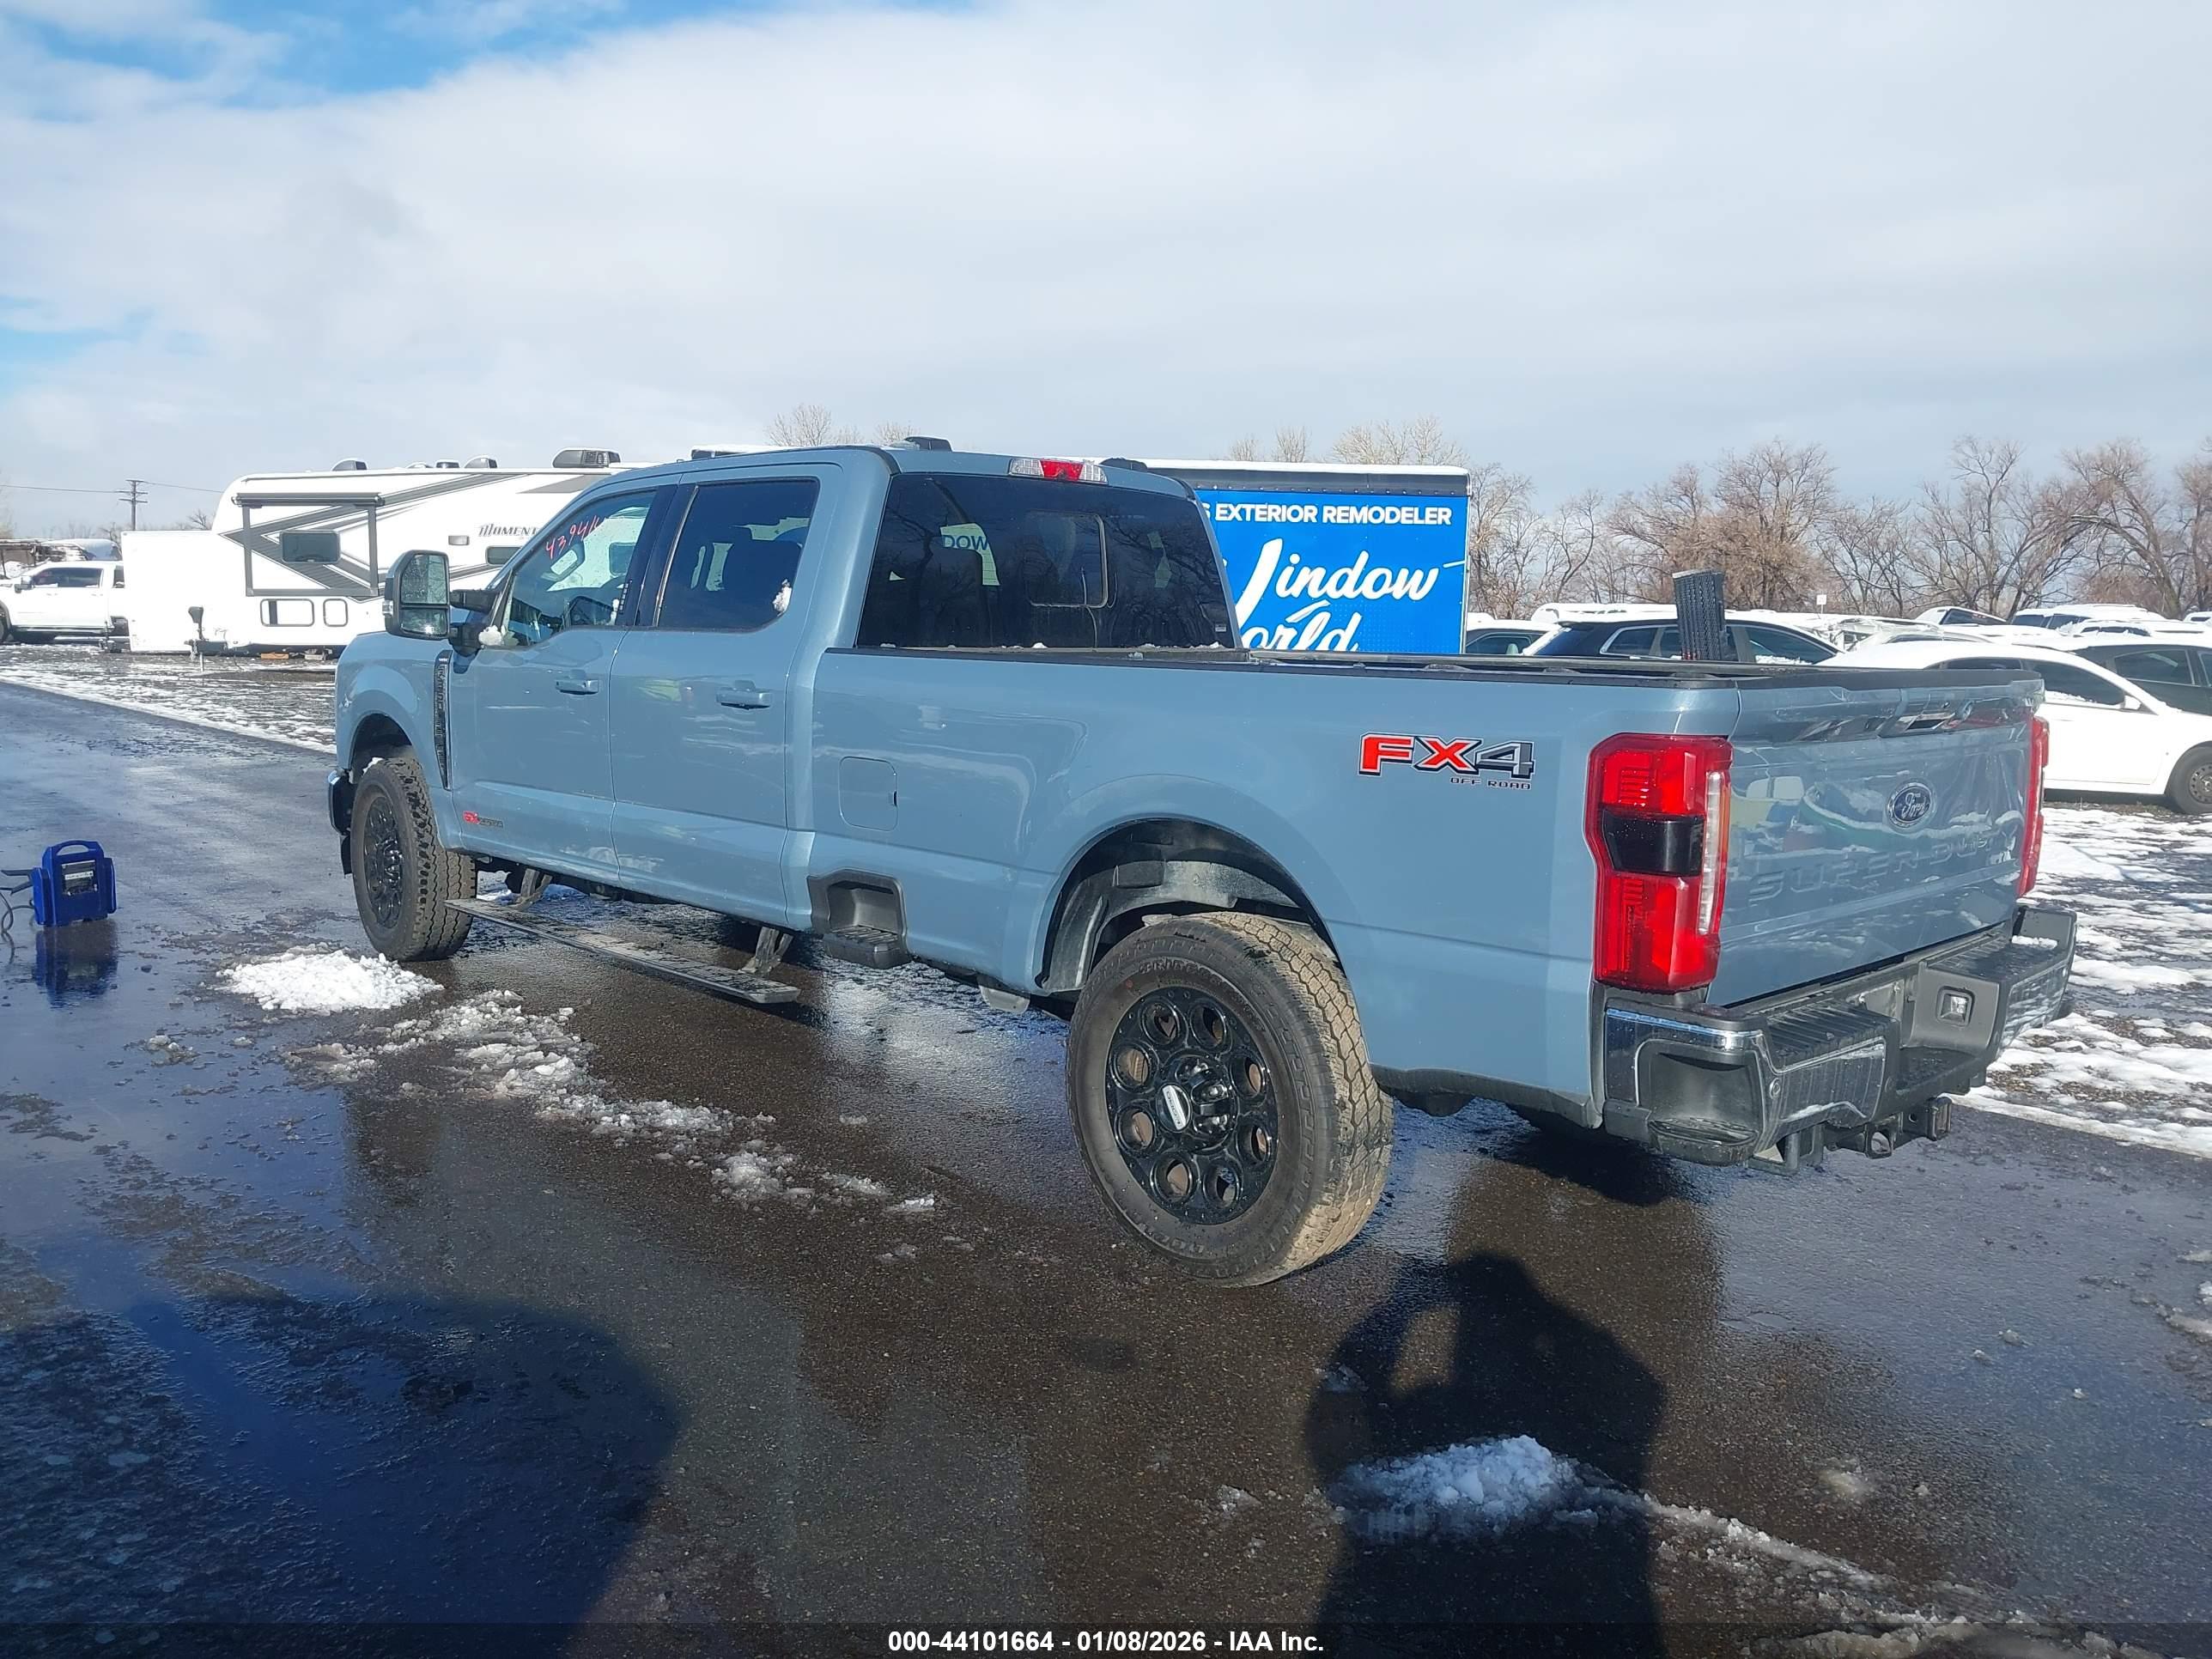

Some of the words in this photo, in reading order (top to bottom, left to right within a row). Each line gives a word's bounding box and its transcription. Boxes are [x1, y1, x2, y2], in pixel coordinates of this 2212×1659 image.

[1216, 503, 1318, 522] EXTERIOR
[1322, 505, 1452, 525] REMODELER
[1358, 732, 1535, 779] FX4
[1449, 776, 1482, 786] OFF
[1487, 779, 1532, 791] ROAD
[1747, 848, 1920, 904] SUPER
